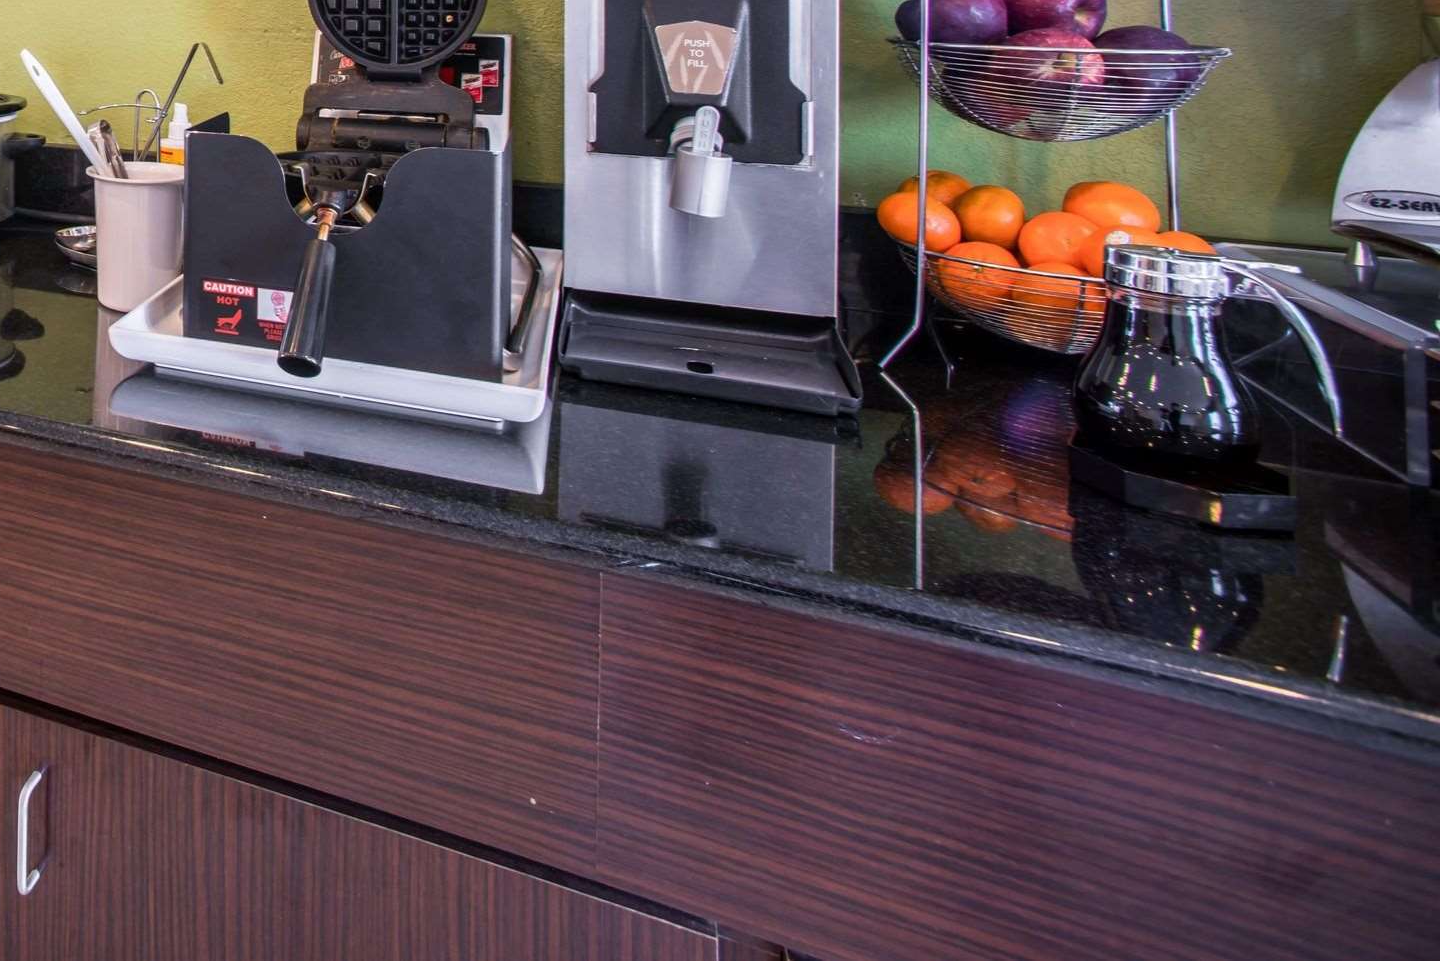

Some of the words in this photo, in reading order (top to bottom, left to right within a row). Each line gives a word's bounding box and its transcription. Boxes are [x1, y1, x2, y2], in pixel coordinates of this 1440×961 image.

[684, 39, 710, 48] PUSH
[689, 50, 704, 58] TO
[687, 60, 706, 68] FILL
[203, 280, 255, 297] CAUTION
[216, 296, 240, 306] HOT
